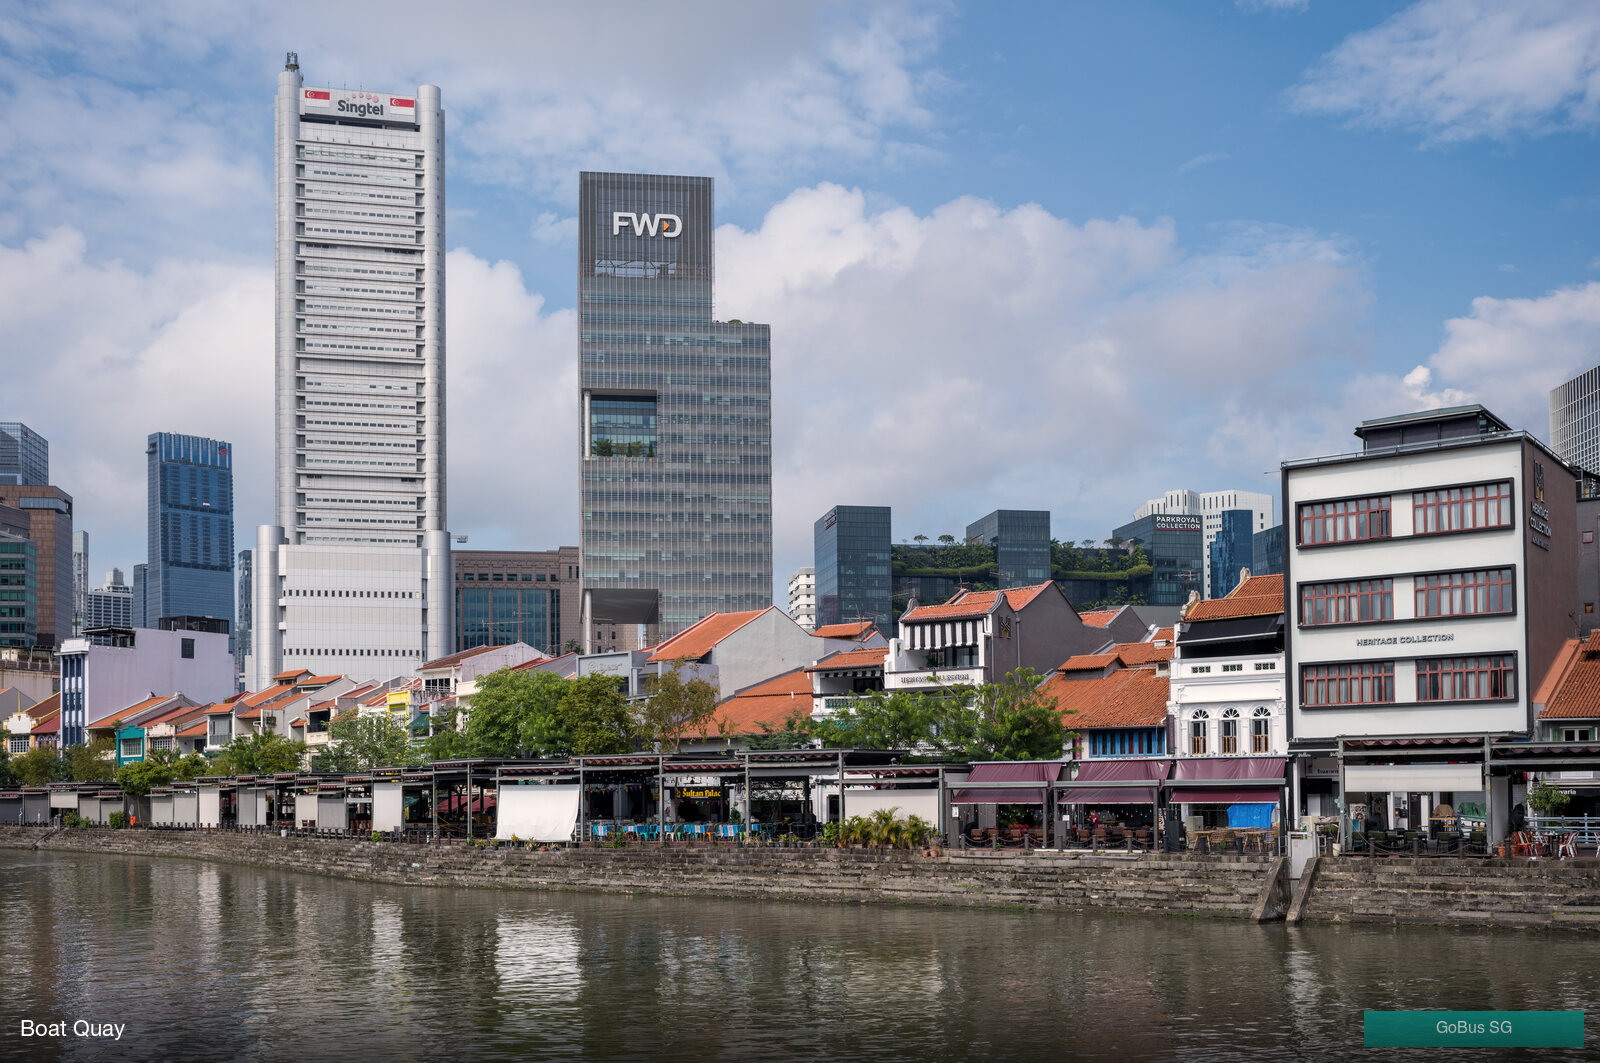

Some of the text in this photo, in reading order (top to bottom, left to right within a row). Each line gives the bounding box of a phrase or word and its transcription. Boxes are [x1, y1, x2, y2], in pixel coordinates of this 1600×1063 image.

[337, 99, 384, 117] Singtel
[613, 211, 683, 238] FWD
[1529, 516, 1552, 537] COLLECTION
[1356, 633, 1455, 646] HERITAGE COLLECTION
[682, 788, 721, 797] Sultan Palac
